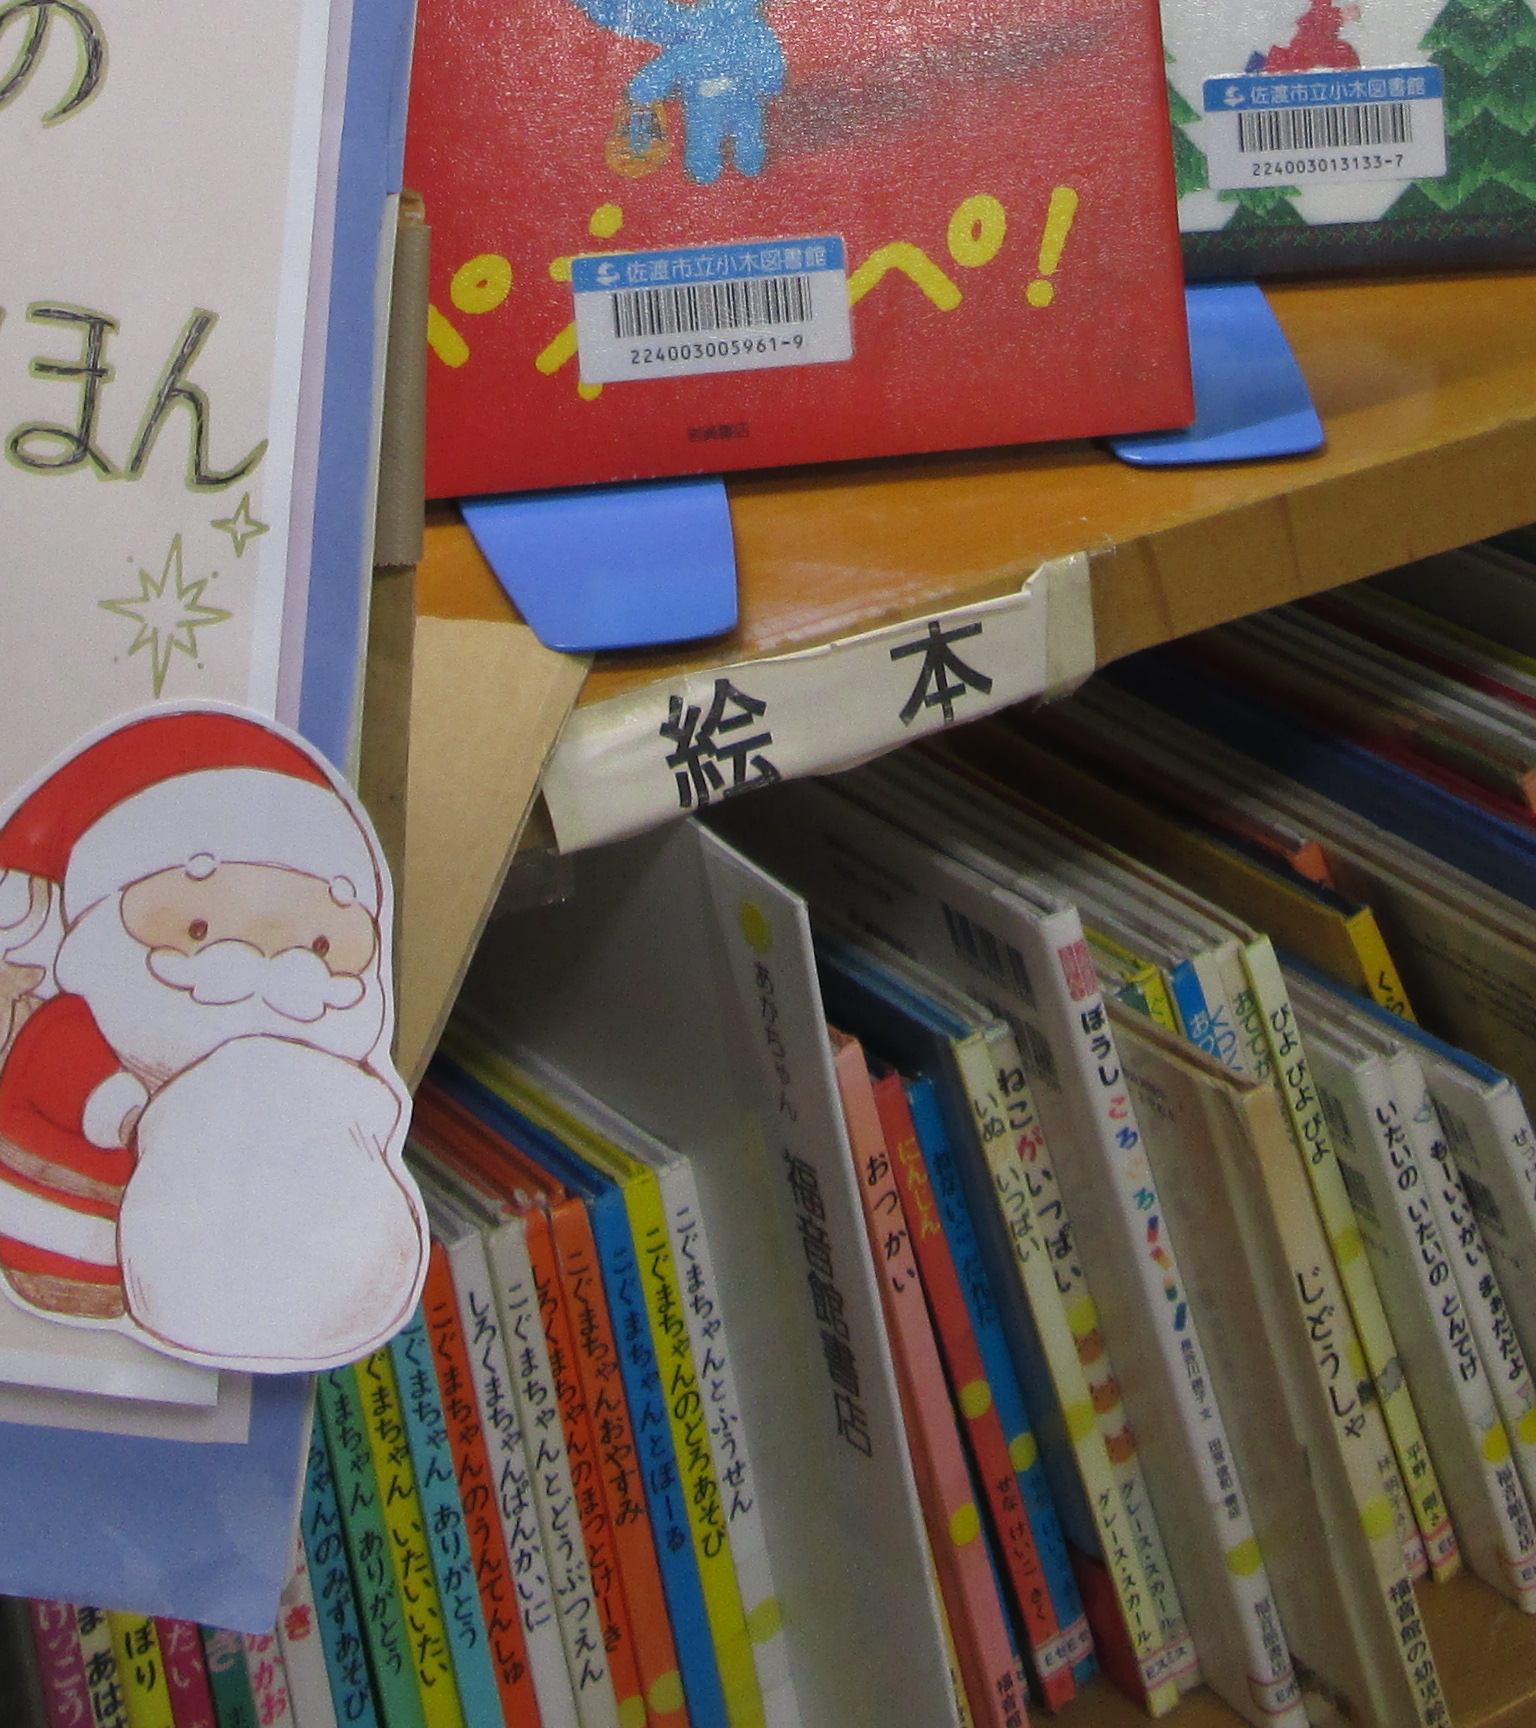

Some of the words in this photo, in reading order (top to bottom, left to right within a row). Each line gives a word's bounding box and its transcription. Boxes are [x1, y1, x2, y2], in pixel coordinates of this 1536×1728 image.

[1248, 77, 1428, 109] 佐渡市立小木図書館
[1252, 152, 1404, 177] 224003013133-7
[626, 245, 827, 283] 佐渡市立小木図書館
[631, 334, 804, 365] 224003005961-9
[659, 620, 994, 809] 絵本
[782, 1145, 875, 1460] 福音館書店
[866, 1153, 916, 1294] おつかい
[1376, 1099, 1419, 1191] いたいの
[1408, 1198, 1450, 1287] いたいの
[1441, 1293, 1478, 1383] とんでけ
[567, 1251, 647, 1527] こぐまちゃんおやすみ
[613, 1247, 687, 1554] こぐまちゃんとぼーる
[645, 1228, 726, 1561] こぐまちゃんのどろあそび
[676, 1207, 753, 1523] こぐまちゃんとふうせん
[1296, 1265, 1367, 1440] じどうしゃ
[431, 1304, 526, 1687] こぐまちゃんのうんてんしゅ
[467, 1290, 552, 1635] しろくまちゃんぱんかいに
[507, 1283, 605, 1688] こぐまちゃんとどうぶつえん
[359, 1529, 404, 1675] ありがとう
[392, 1522, 449, 1688] いたいいたい
[433, 1503, 478, 1649] ありがとう
[1388, 1577, 1450, 1728] 福音館の幼児絵
